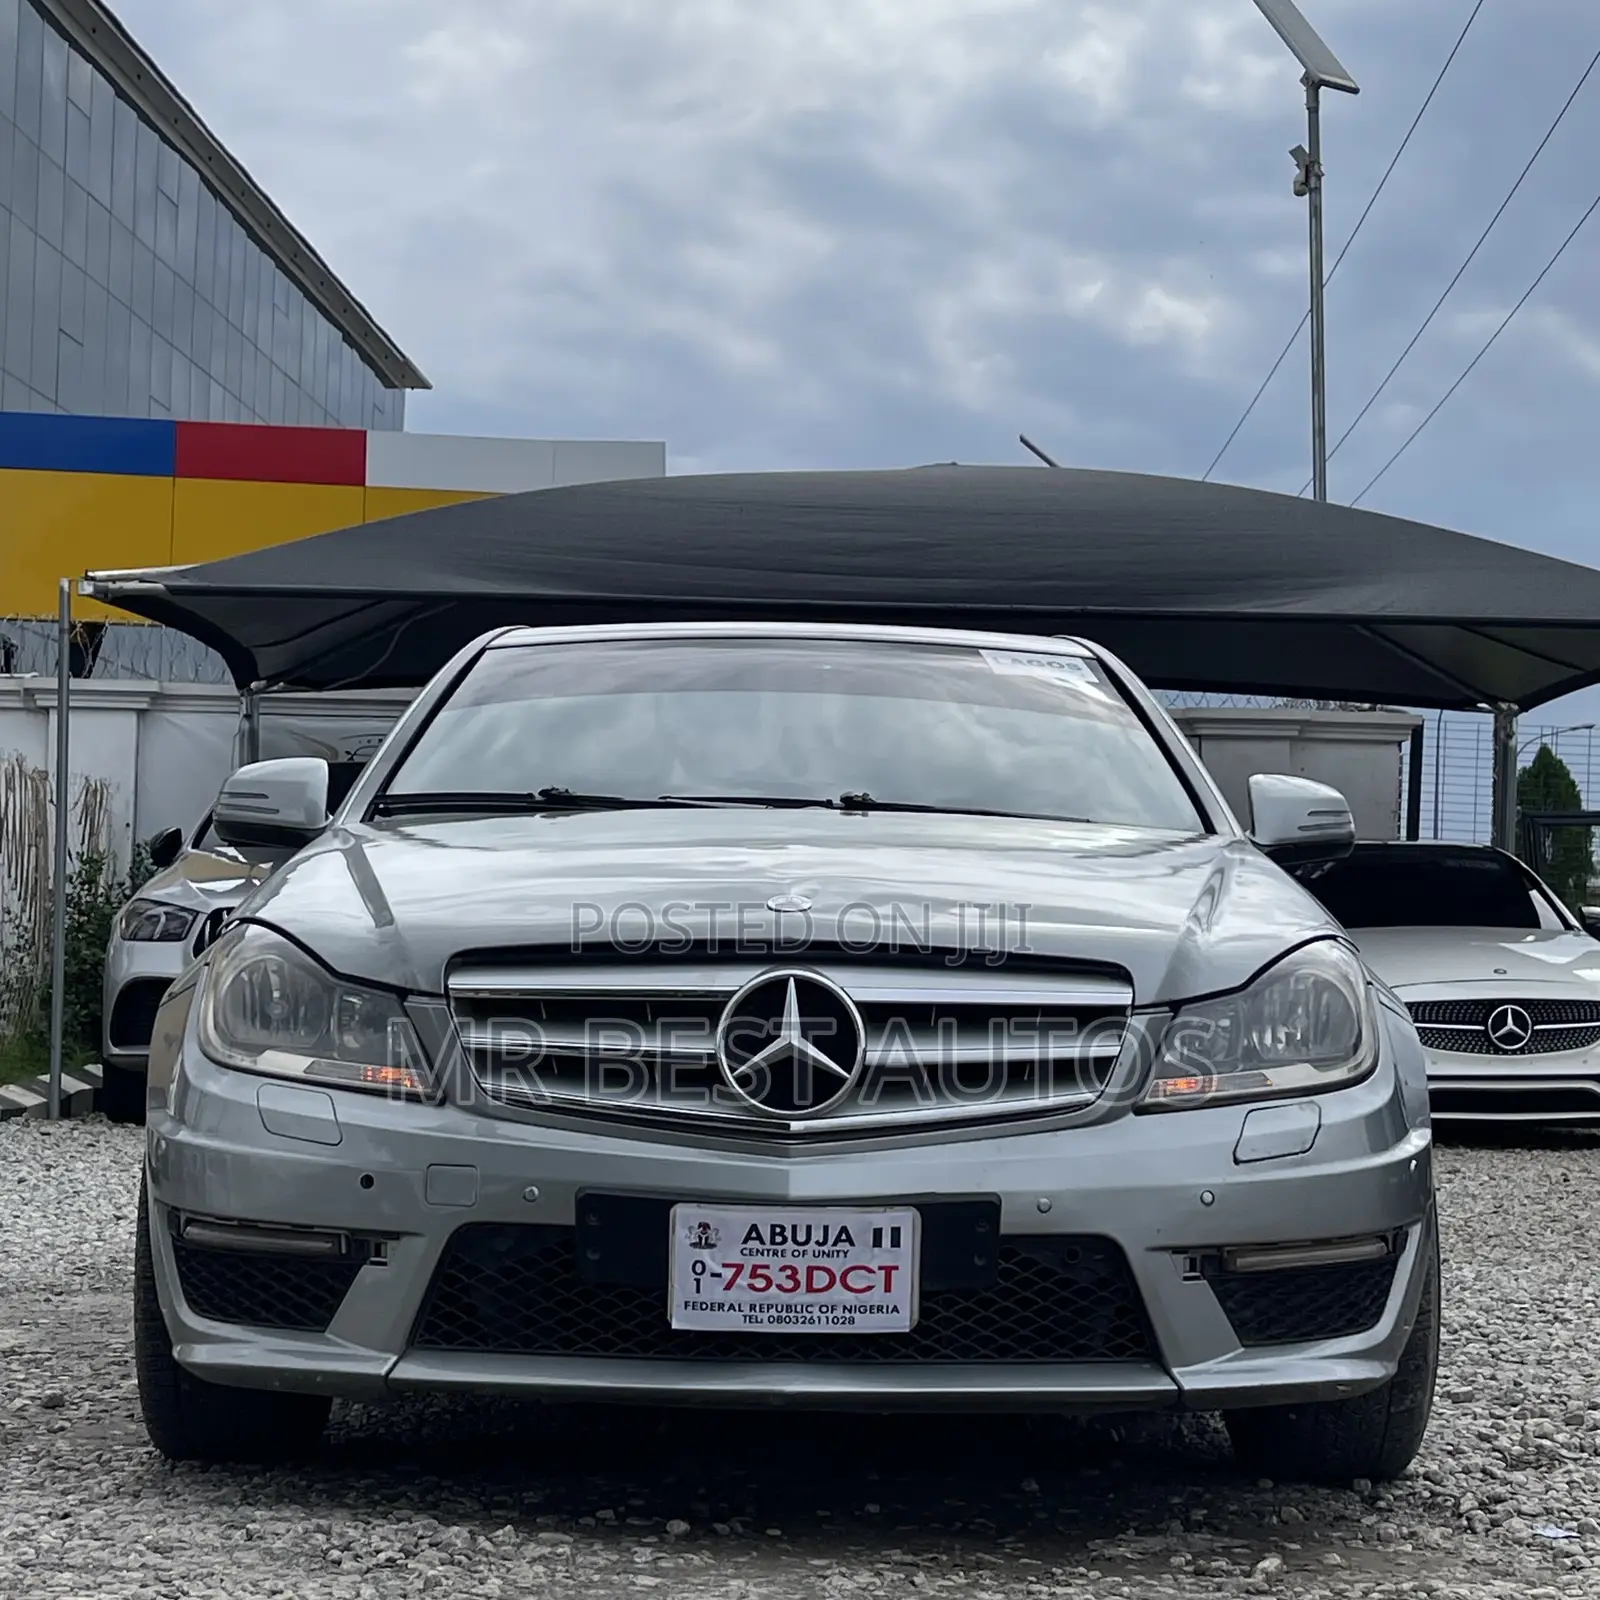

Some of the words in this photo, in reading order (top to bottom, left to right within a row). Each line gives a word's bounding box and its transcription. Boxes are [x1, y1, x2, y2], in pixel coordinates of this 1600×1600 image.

[740, 1223, 856, 1248] ABUJA
[740, 1247, 787, 1258] CENTRE
[791, 1248, 809, 1258] OF
[813, 1249, 850, 1259] UNITY
[683, 1300, 744, 1313] FEDERAL
[749, 1302, 814, 1314] REPUBLIC
[818, 1304, 843, 1315] OF
[845, 1304, 901, 1315] NIGERIA
[767, 1315, 856, 1326] 08032611028
